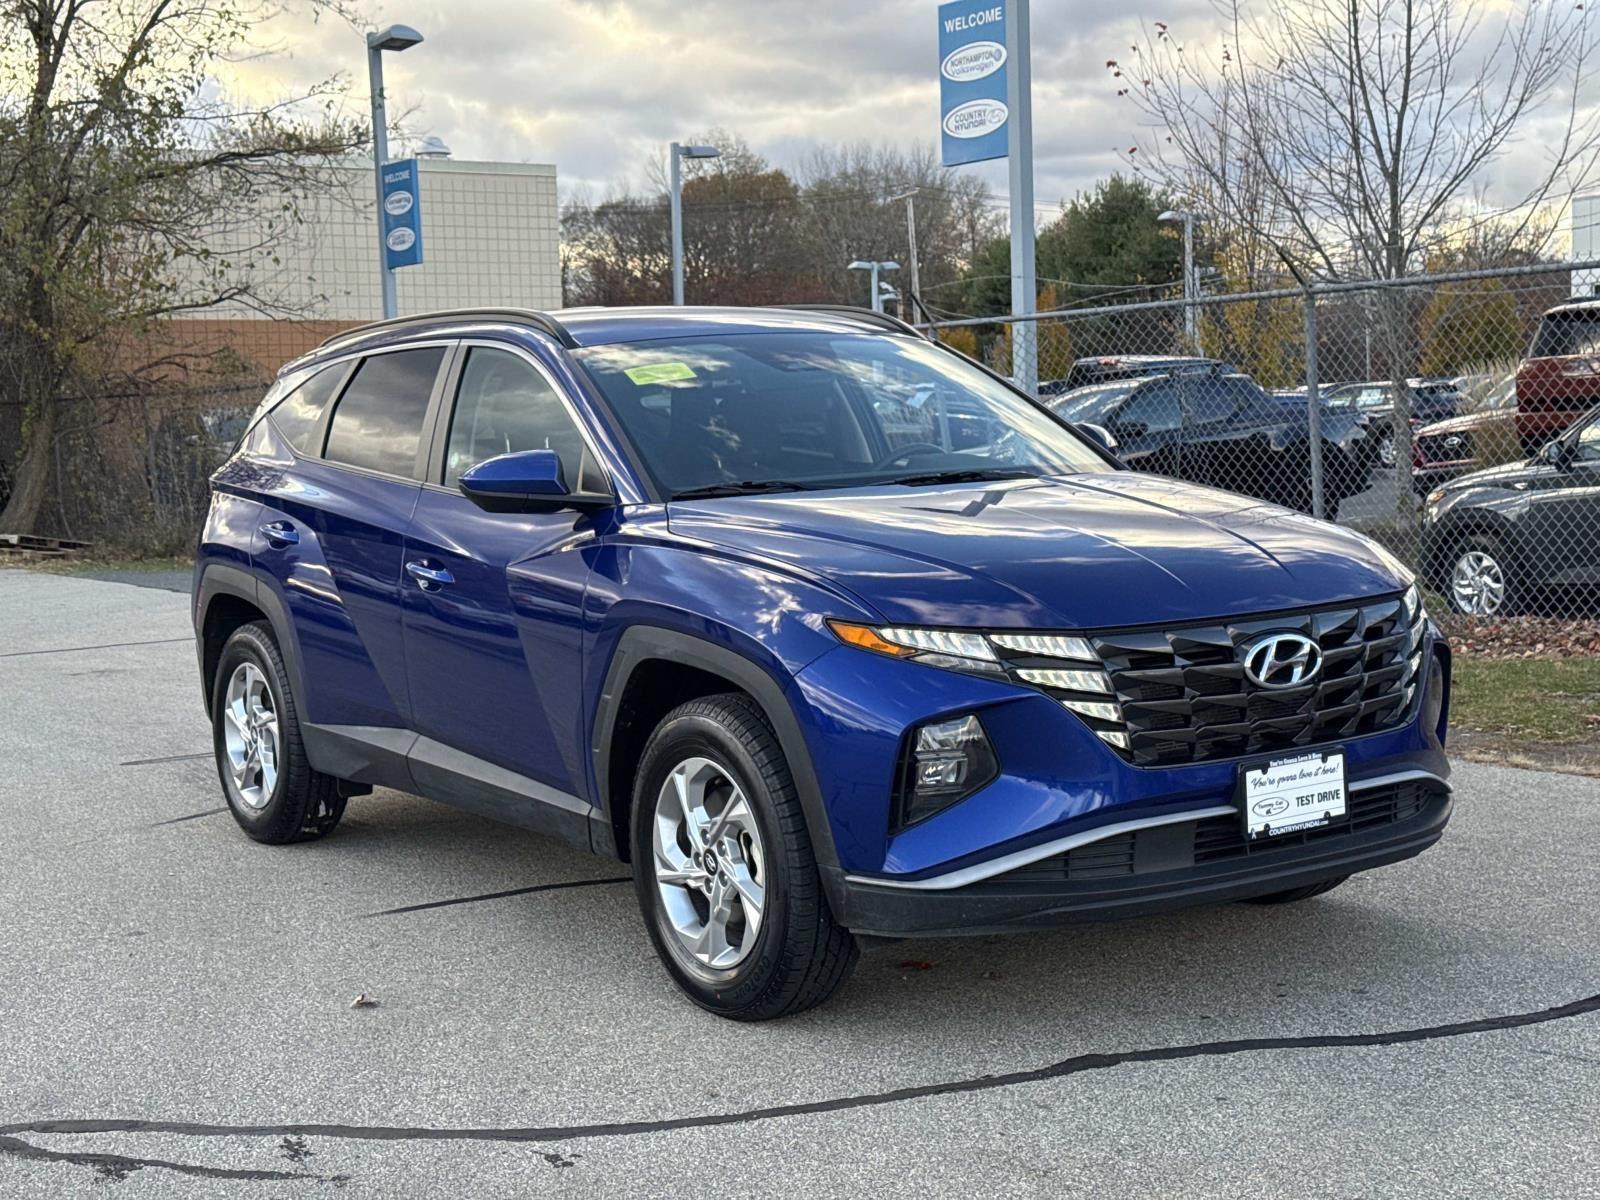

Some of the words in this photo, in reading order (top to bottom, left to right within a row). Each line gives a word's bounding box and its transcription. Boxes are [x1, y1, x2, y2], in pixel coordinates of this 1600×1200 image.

[944, 7, 1003, 33] WELCOME
[950, 50, 994, 67] NORTHAMPTON
[954, 109, 987, 124] COUNTRY
[1251, 776, 1276, 790] You're
[1298, 769, 1313, 781] love
[1313, 766, 1322, 777] it
[1295, 794, 1315, 807] TEST
[1317, 789, 1341, 803] DRIVE
